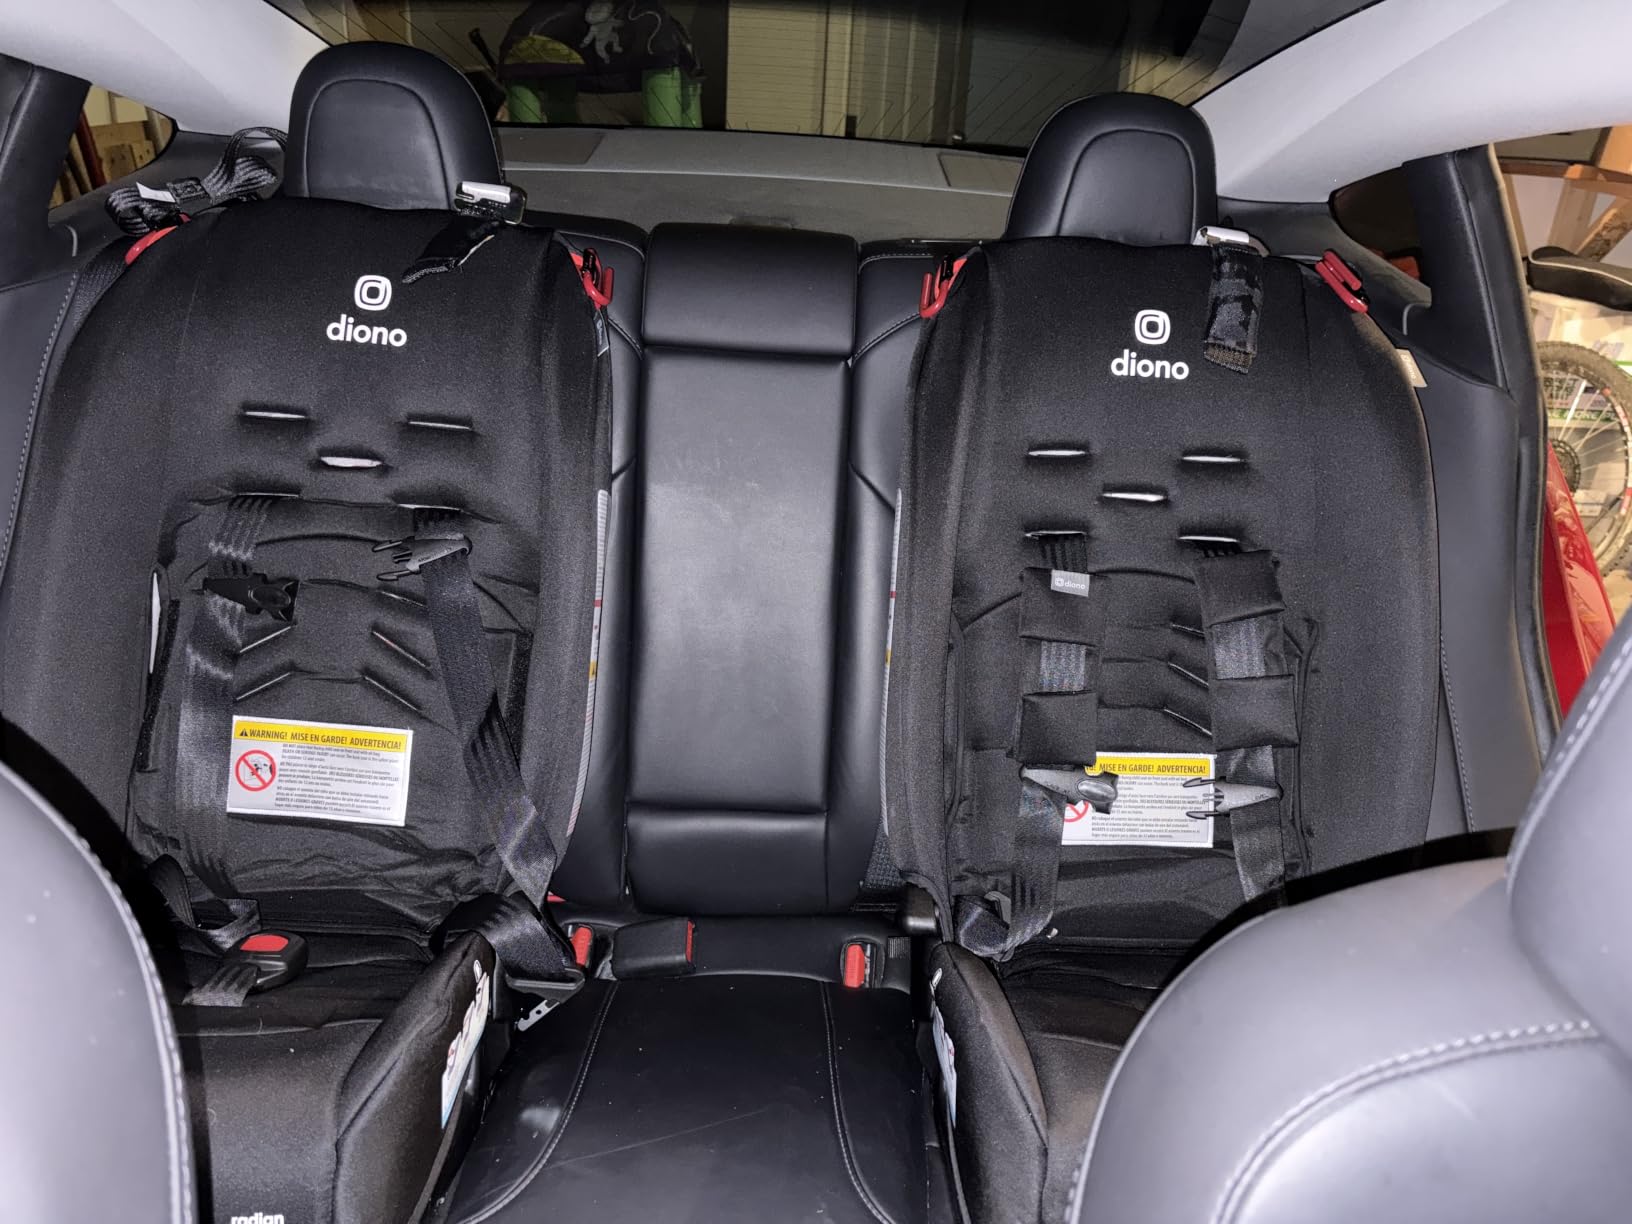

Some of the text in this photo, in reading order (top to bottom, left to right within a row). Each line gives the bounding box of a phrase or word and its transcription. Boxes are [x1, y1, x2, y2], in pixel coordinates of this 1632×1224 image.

[326, 314, 407, 347] diono
[1111, 349, 1189, 380] diono
[1065, 580, 1086, 589] diono
[250, 729, 401, 749] WARNING! MISE EN GARDE! ADVERTENCIA!
[1100, 764, 1116, 772] MISE
[1118, 764, 1127, 772] EN
[1129, 764, 1154, 773] GARDE!
[1157, 765, 1206, 774] ADVERTENCIA!
[231, 1212, 285, 1224] radian
